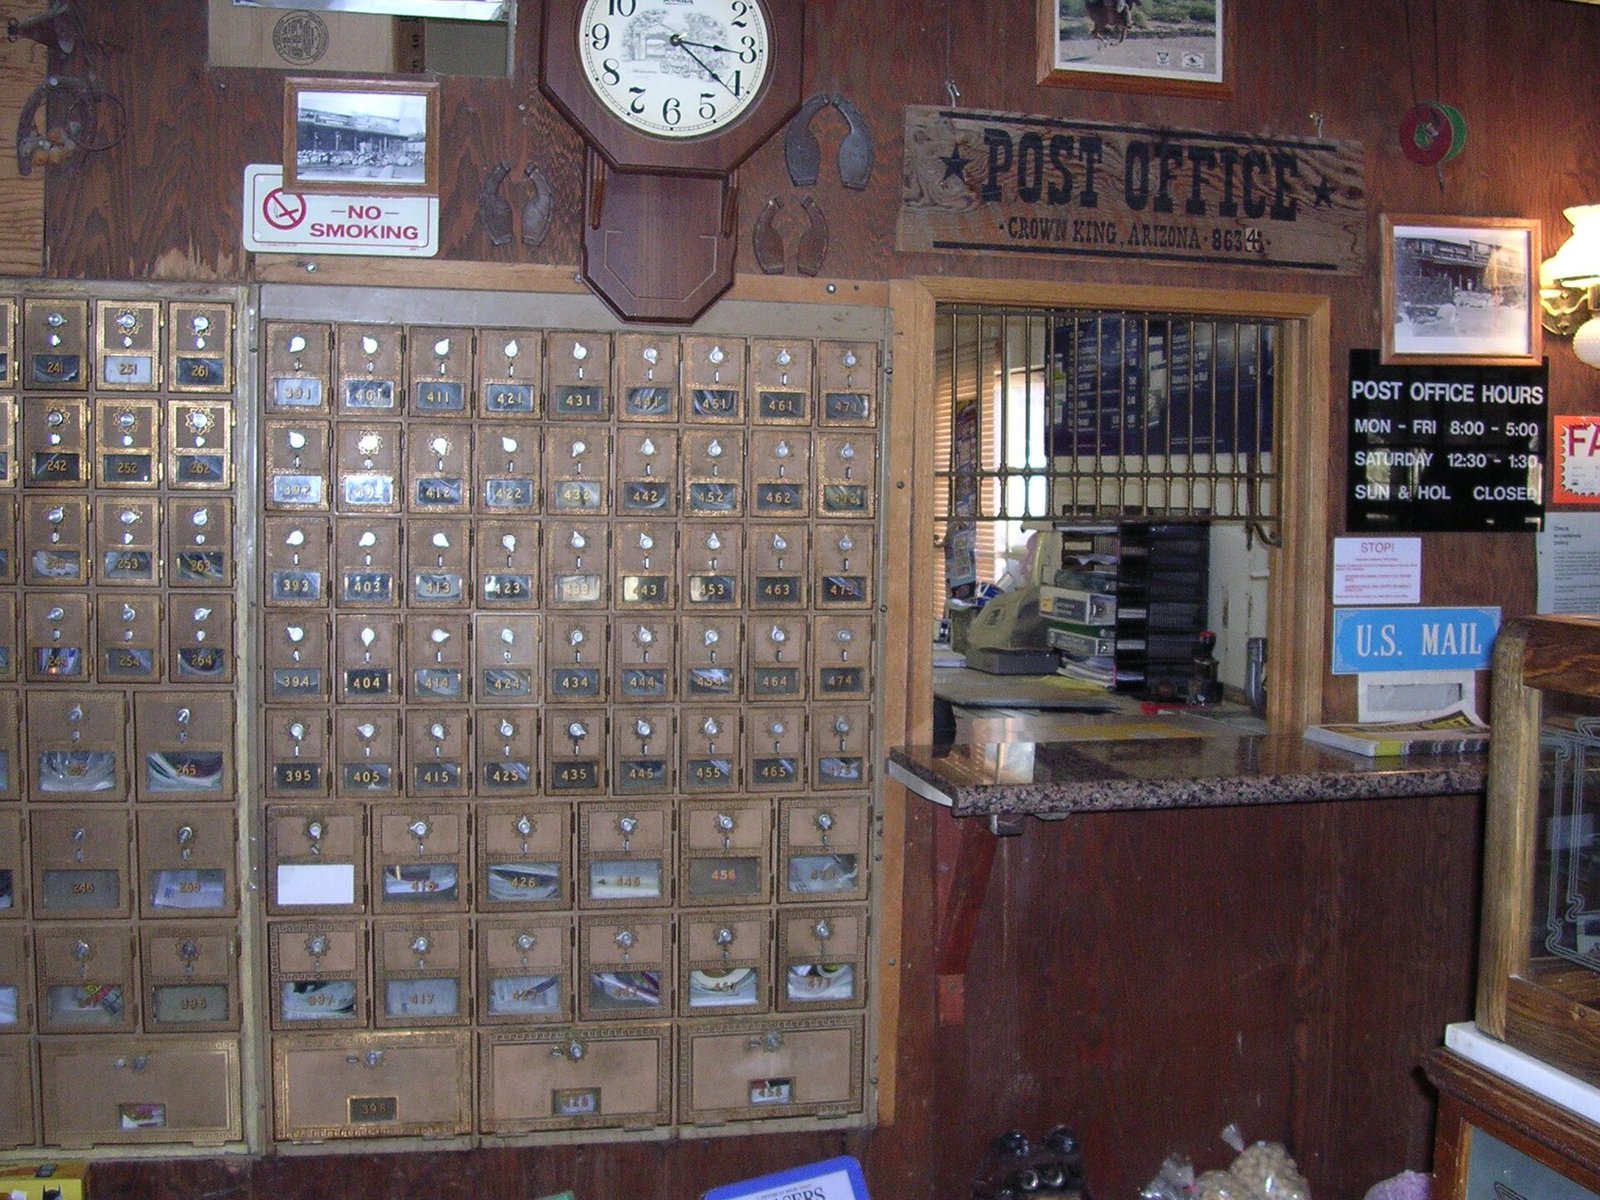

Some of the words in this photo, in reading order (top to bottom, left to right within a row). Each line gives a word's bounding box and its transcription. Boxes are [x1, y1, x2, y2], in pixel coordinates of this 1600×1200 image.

[731, 1, 748, 28] 2
[592, 23, 610, 50] 9
[739, 36, 757, 64] 3
[602, 58, 620, 86] 8
[725, 70, 744, 96] 4
[629, 86, 646, 114] 7
[699, 93, 716, 119] 5
[662, 98, 681, 125] 6
[982, 128, 1103, 207] POST
[1125, 140, 1300, 221] OFFICE
[347, 205, 382, 221] NO
[310, 223, 418, 240] SMOKING
[1008, 220, 1067, 242] CROWN
[1128, 227, 1201, 250] ARIZONA
[47, 362, 64, 374] 241
[118, 363, 138, 376] 251
[191, 366, 209, 378] 261
[1352, 381, 1403, 400] POST
[1410, 382, 1475, 402] OFFICE
[1482, 385, 1544, 405] HOURS
[1355, 418, 1391, 433] MON
[1413, 420, 1437, 434] FRI
[1450, 420, 1485, 435] 8:00
[1505, 422, 1538, 436] 5:00
[47, 460, 67, 472] 242
[1355, 451, 1434, 467] SATURDAY
[1447, 453, 1487, 468] 12:30
[1508, 454, 1539, 469] 1:30
[1355, 485, 1391, 499] SUN
[1398, 485, 1411, 499] &
[1417, 486, 1451, 500] HOL
[1473, 486, 1539, 500] CLOSED
[1361, 542, 1395, 553] STOP!
[117, 558, 138, 570] 253
[283, 580, 309, 592] 393
[354, 581, 380, 592] 403
[764, 584, 790, 596] 463
[1356, 624, 1403, 656] U.S.
[1421, 623, 1482, 656] MAIL
[283, 676, 310, 688] 394
[353, 677, 380, 688] 404
[494, 678, 520, 690] 424
[562, 677, 589, 688] 434
[176, 765, 197, 777] 265
[286, 770, 312, 782] 395
[353, 771, 380, 783] 405
[423, 771, 449, 783] 415
[492, 770, 519, 782] 425
[561, 769, 588, 781] 435
[628, 768, 655, 780] 445
[696, 767, 722, 779] 455
[761, 766, 787, 778] 465
